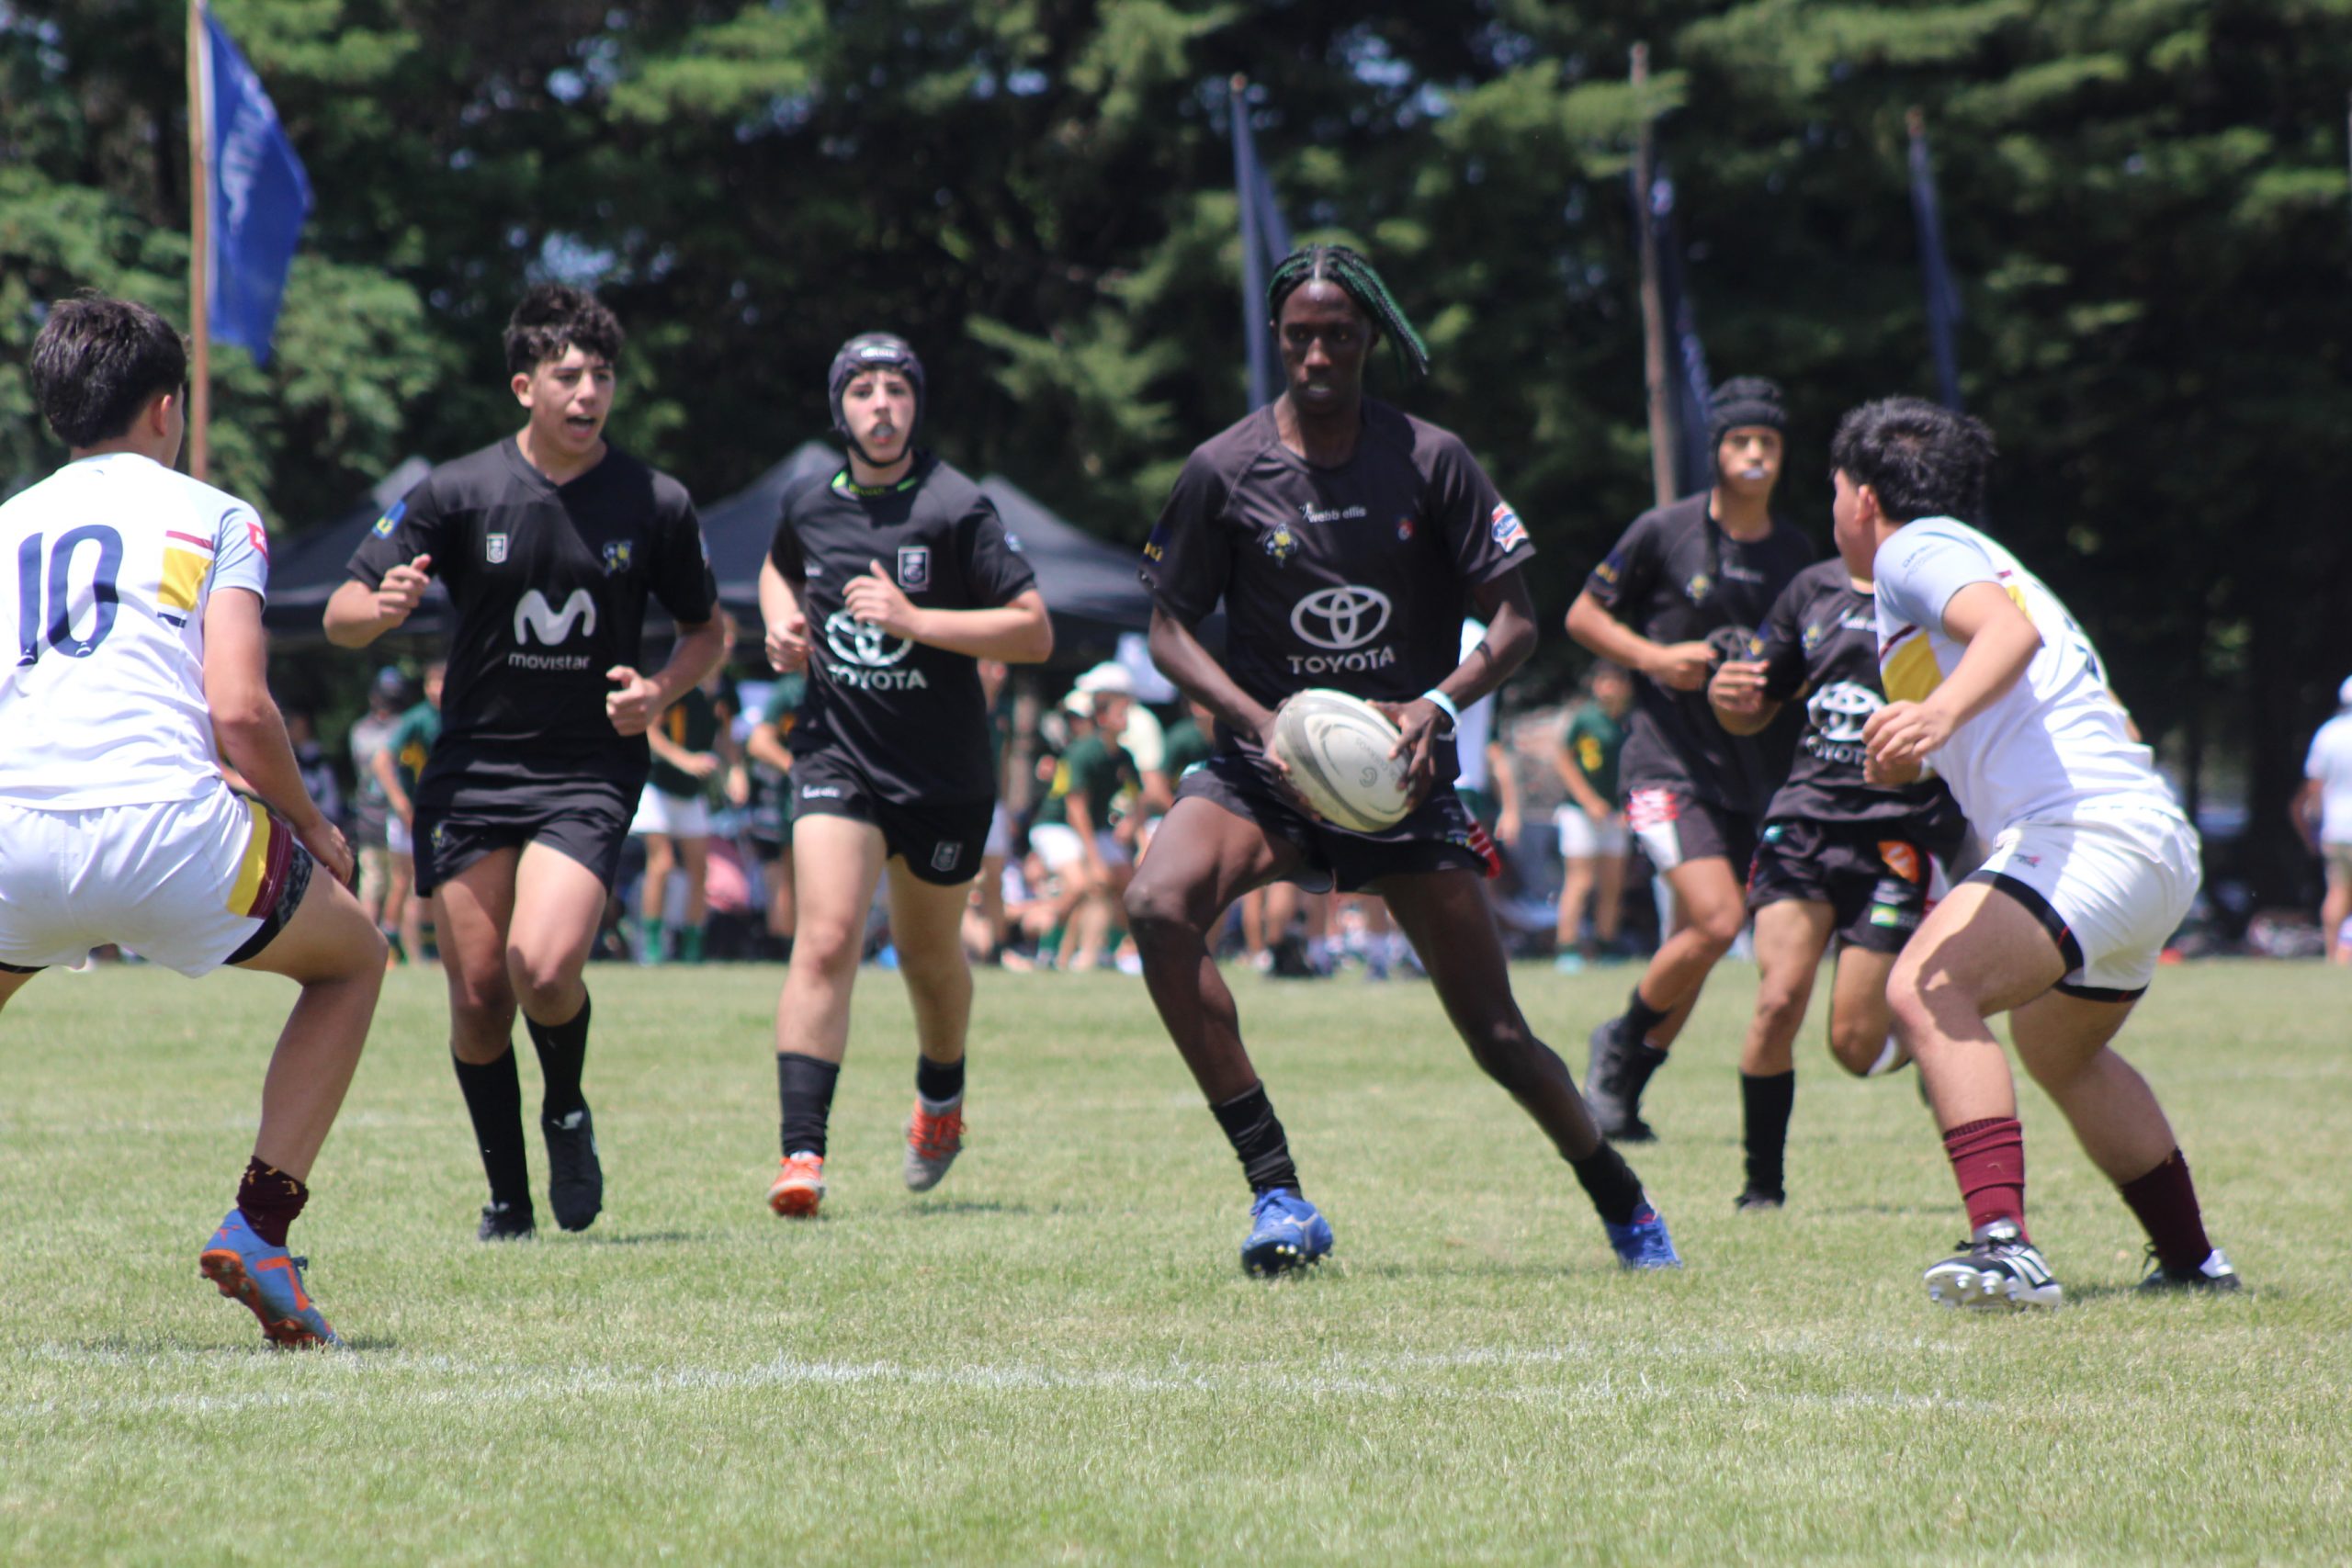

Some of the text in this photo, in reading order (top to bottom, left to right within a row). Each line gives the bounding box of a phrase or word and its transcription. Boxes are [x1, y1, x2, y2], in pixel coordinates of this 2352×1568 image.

[1307, 505, 1367, 523] webb ellis
[17, 525, 124, 667] 10
[507, 653, 591, 670] movistar
[1286, 646, 1396, 674] TOYOTA
